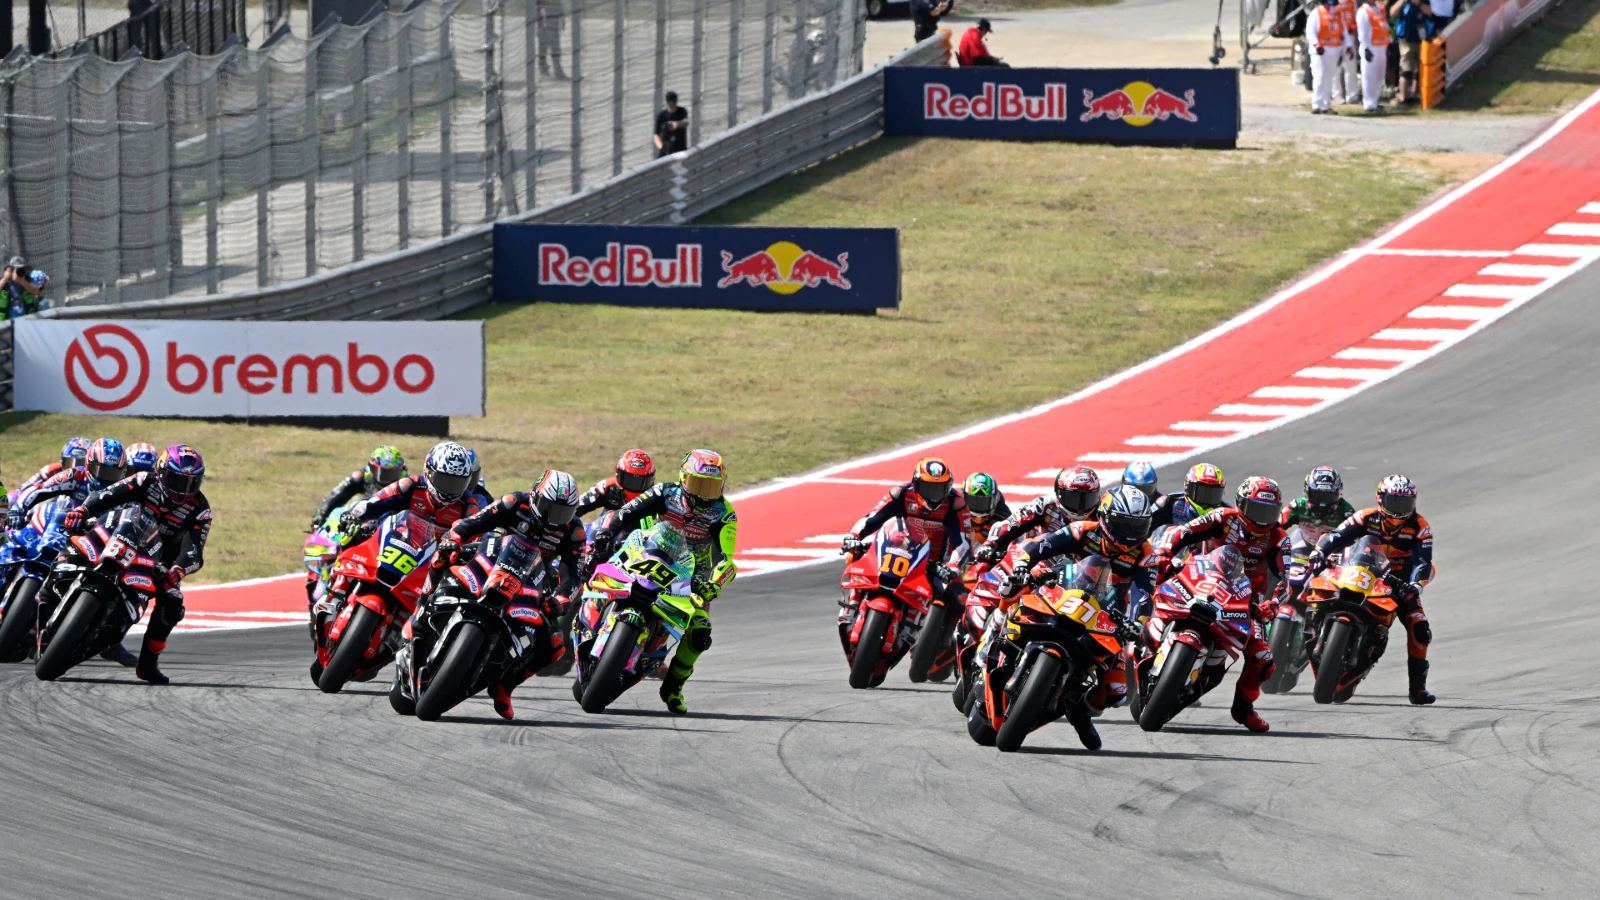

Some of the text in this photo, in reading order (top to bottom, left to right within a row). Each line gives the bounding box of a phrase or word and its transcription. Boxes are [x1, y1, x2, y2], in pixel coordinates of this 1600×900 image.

[924, 82, 1067, 120] Red Bull
[538, 242, 702, 287] Red Bull
[167, 342, 435, 394] brembo
[101, 539, 137, 569] 89
[352, 554, 367, 563] IBM
[376, 546, 418, 575] 36
[880, 554, 910, 577] 10
[1118, 554, 1136, 564] KTM
[627, 558, 679, 588] 49
[1344, 569, 1372, 590] 23
[1173, 578, 1192, 600] Lenovo
[1194, 579, 1232, 606] 93
[1057, 596, 1097, 624] 37
[1222, 611, 1248, 619] Lenovo
